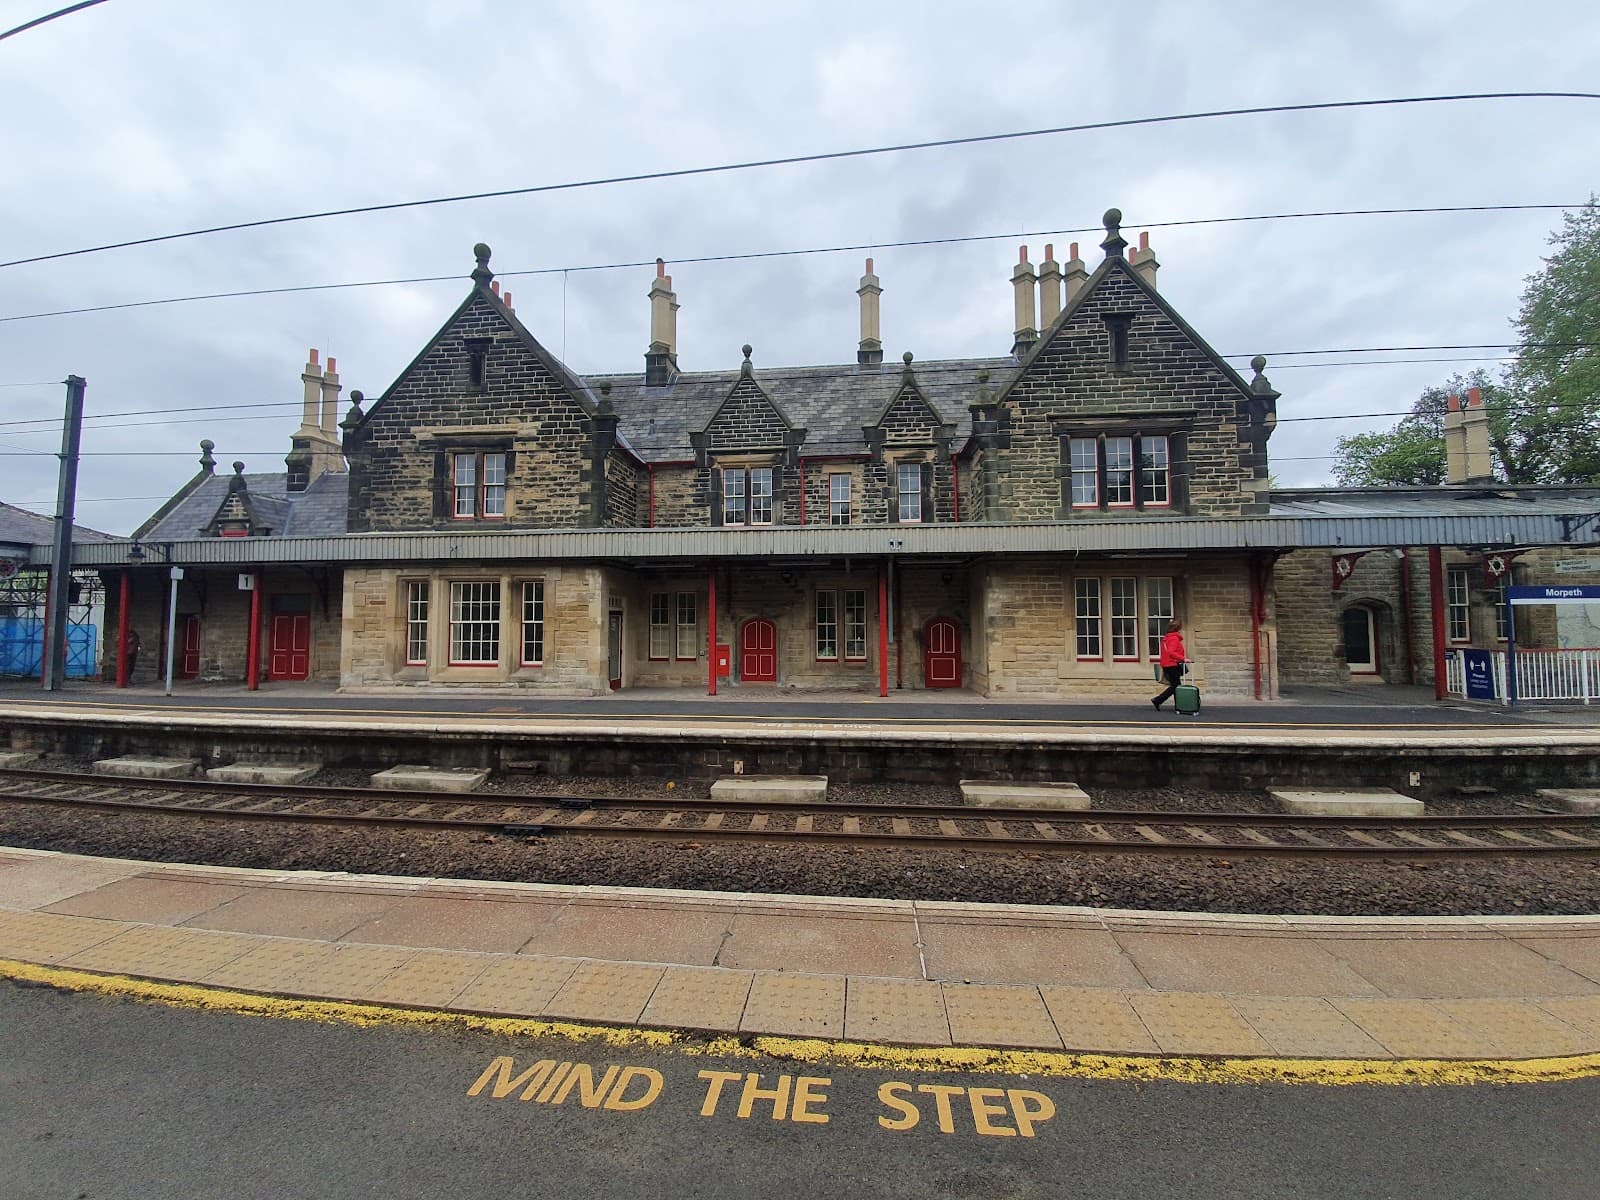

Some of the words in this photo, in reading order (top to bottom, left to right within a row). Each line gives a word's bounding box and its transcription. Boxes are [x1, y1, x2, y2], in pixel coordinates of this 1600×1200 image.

[244, 576, 248, 588] 1
[1545, 588, 1583, 598] Morpeth
[466, 1055, 664, 1112] MIND
[697, 1069, 832, 1124] THE
[877, 1081, 1057, 1138] STEP
